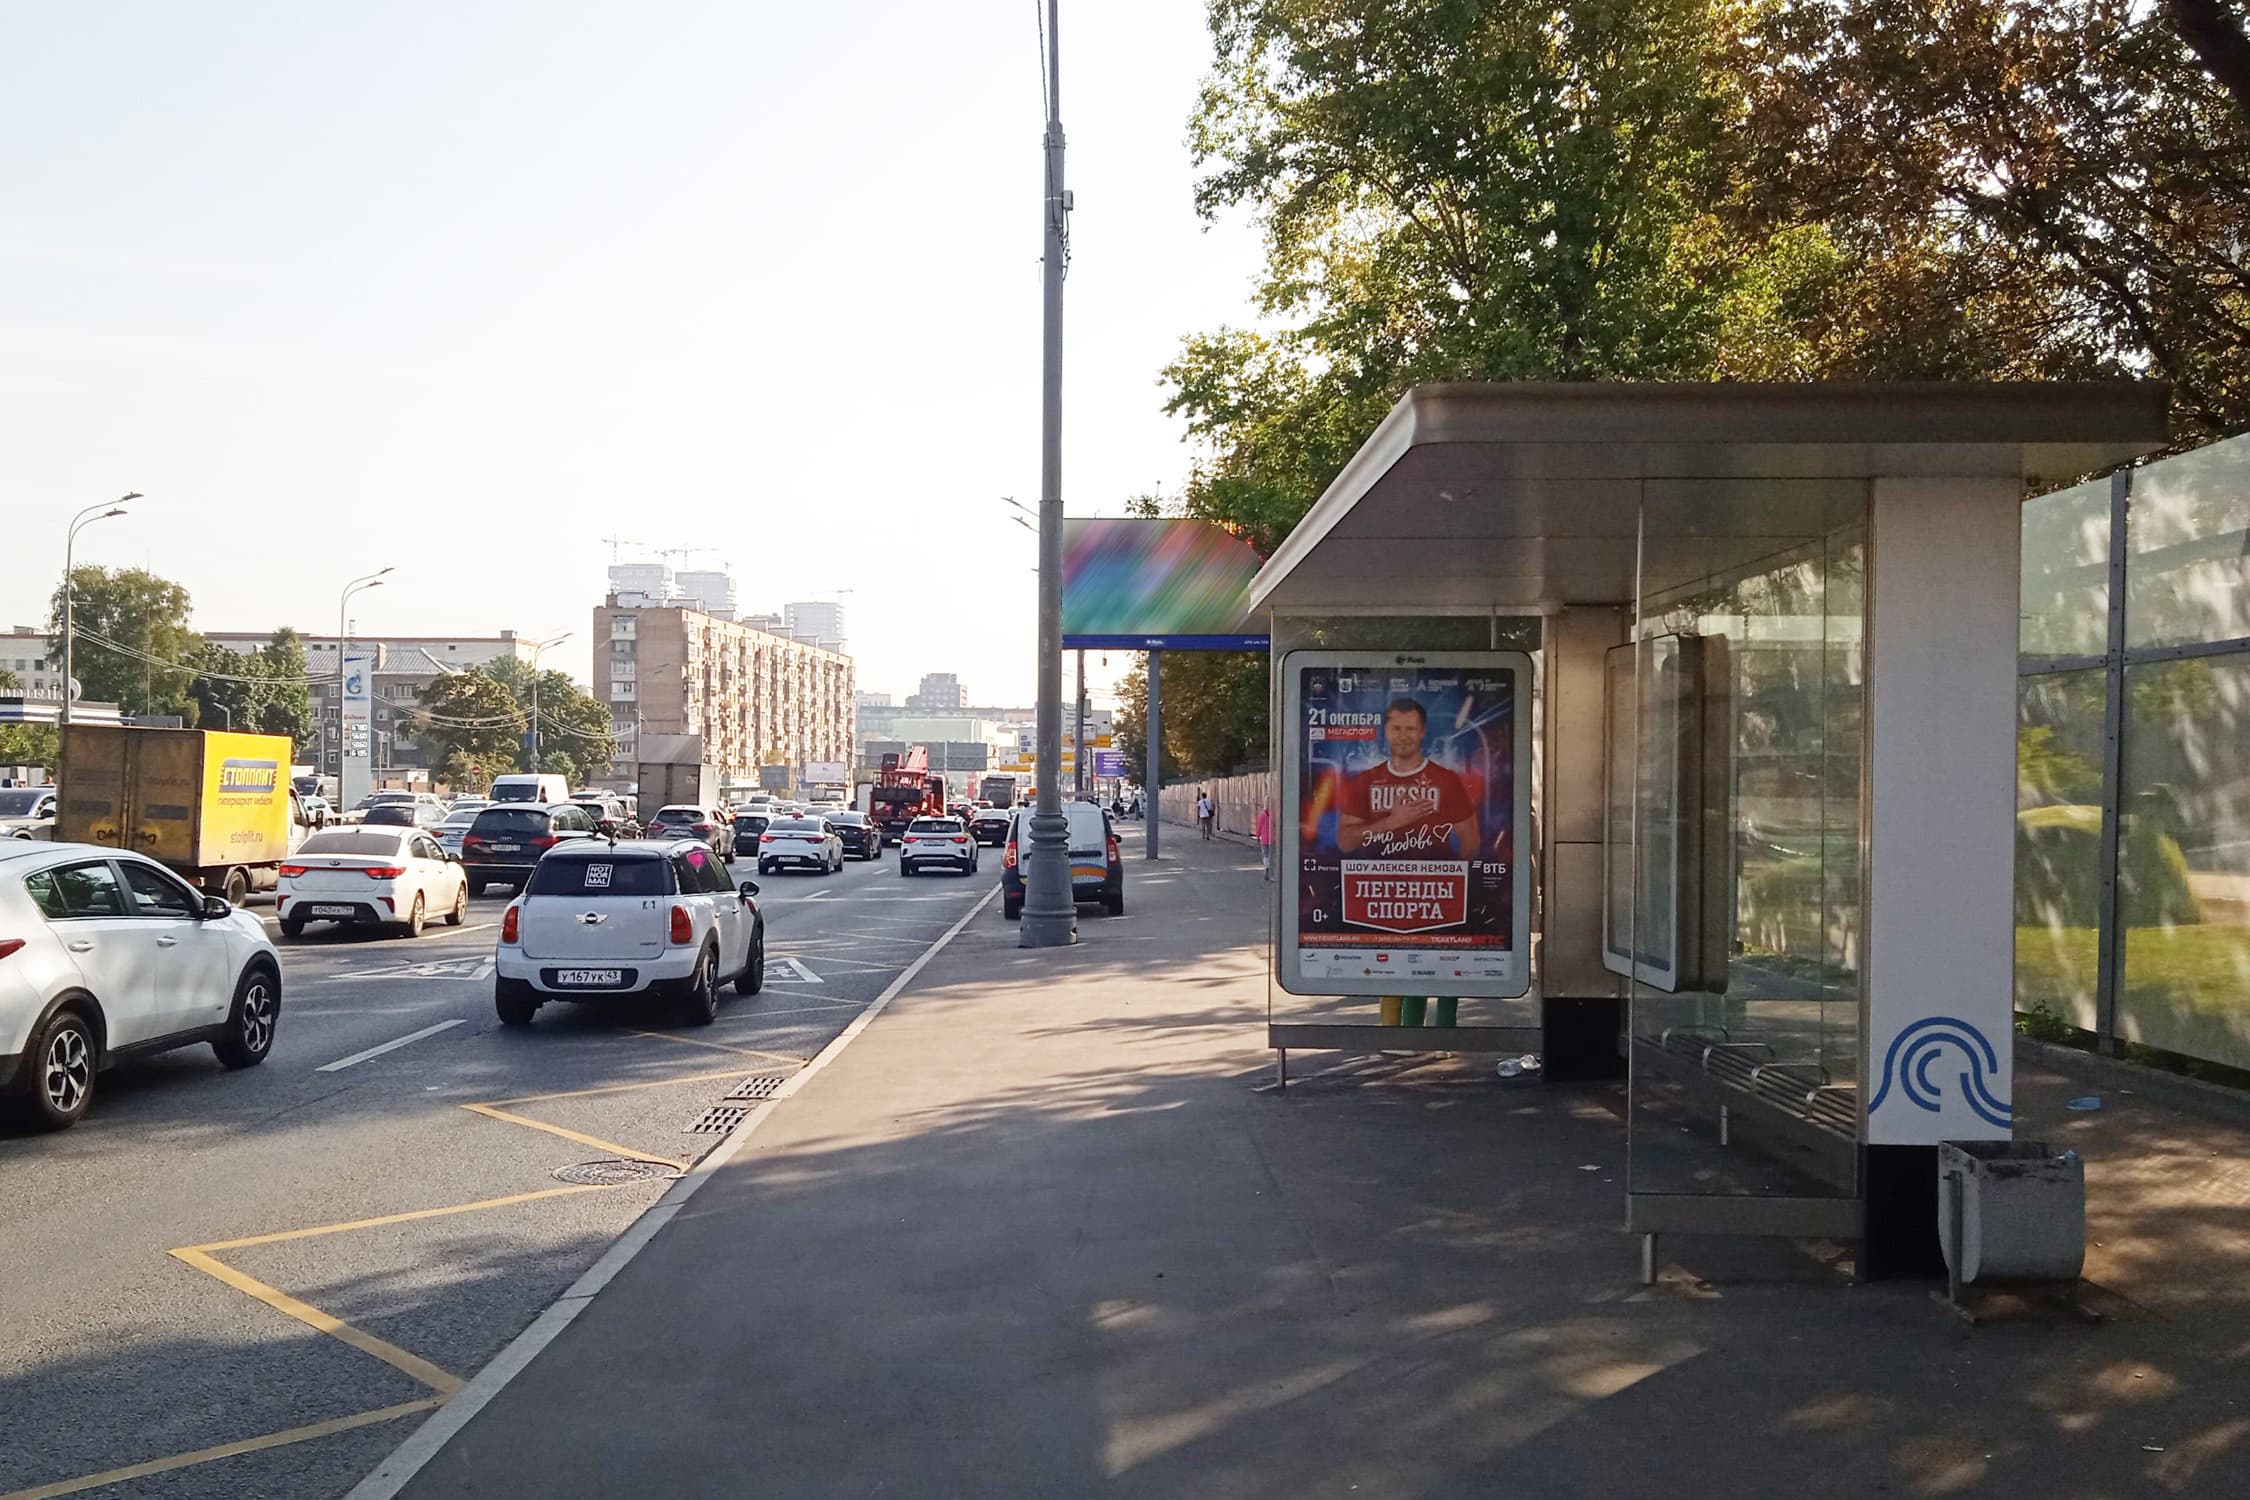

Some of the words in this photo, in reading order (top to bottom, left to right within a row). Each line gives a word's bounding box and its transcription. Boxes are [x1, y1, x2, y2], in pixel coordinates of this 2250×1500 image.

[1308, 708, 1326, 726] 21
[1330, 713, 1381, 726] ОКТЯБРЯ
[1346, 863, 1369, 872] ШОУ
[1372, 863, 1417, 872] АЛЕКСЕЯ
[1420, 864, 1463, 873] НЕМОВА
[1483, 863, 1506, 874] ВТБ
[1355, 881, 1454, 900] ЛЕГЕНДЫ
[1313, 908, 1329, 922] 0+
[1367, 902, 1444, 919] СПОРТА
